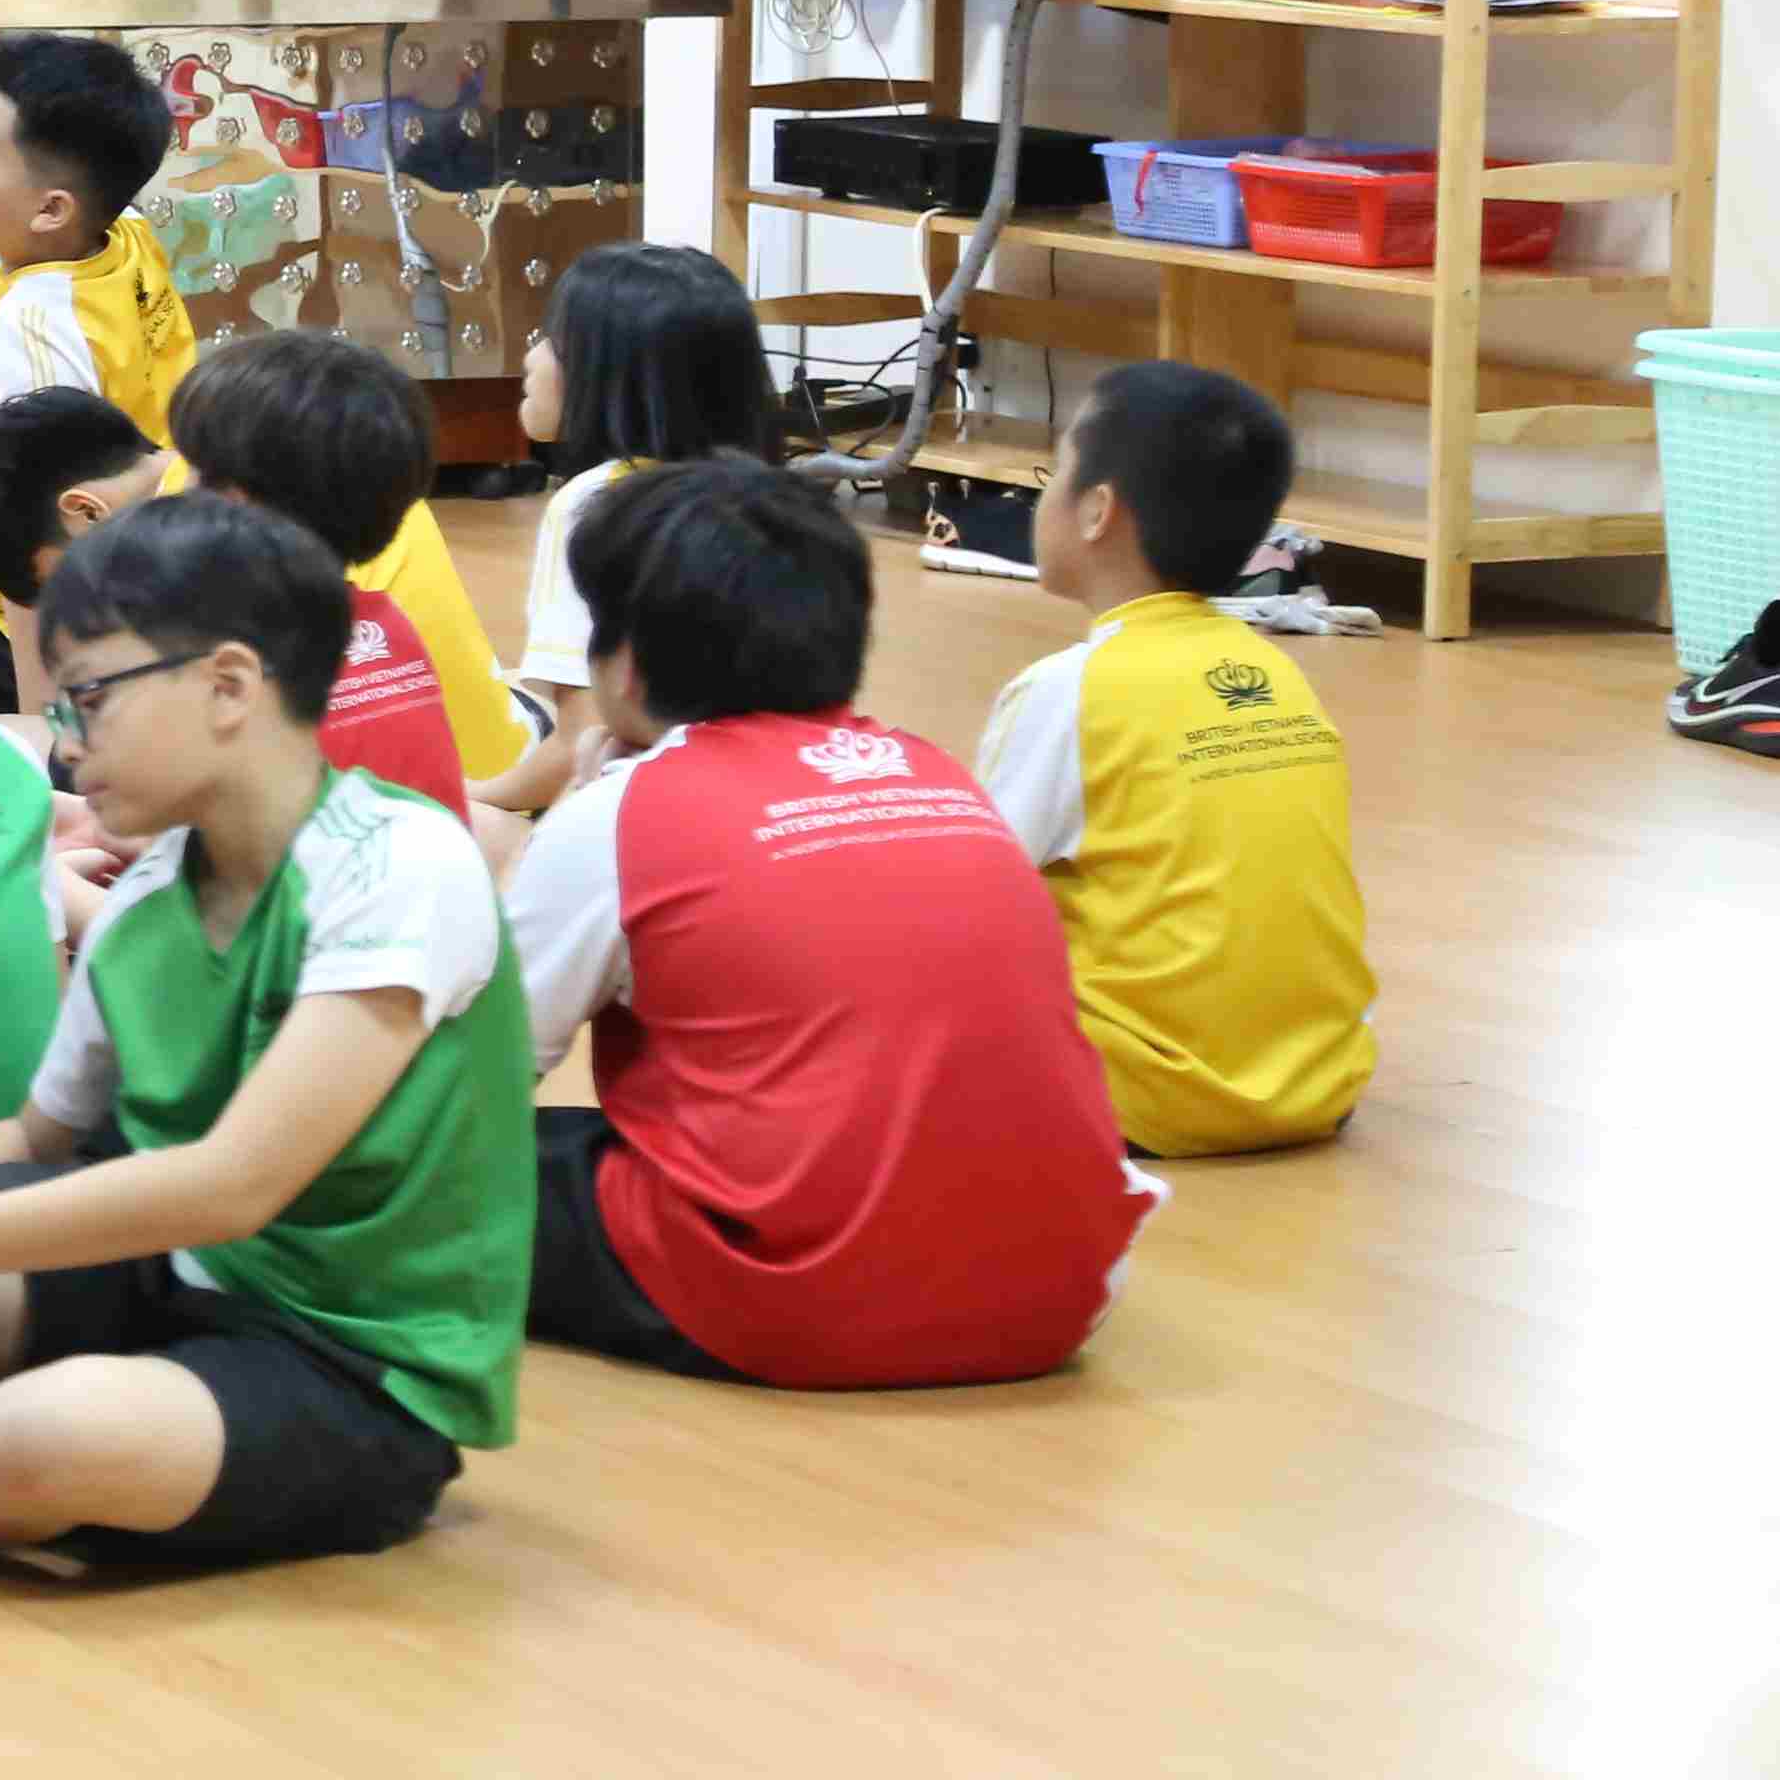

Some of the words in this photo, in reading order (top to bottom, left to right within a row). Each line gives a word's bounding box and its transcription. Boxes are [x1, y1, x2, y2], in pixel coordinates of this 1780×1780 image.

[1184, 724, 1241, 745] BRITISH
[1176, 734, 1294, 766] INTERNATIONAL
[762, 792, 861, 820] BRITISH
[752, 803, 937, 844] INTERNATIONAL
